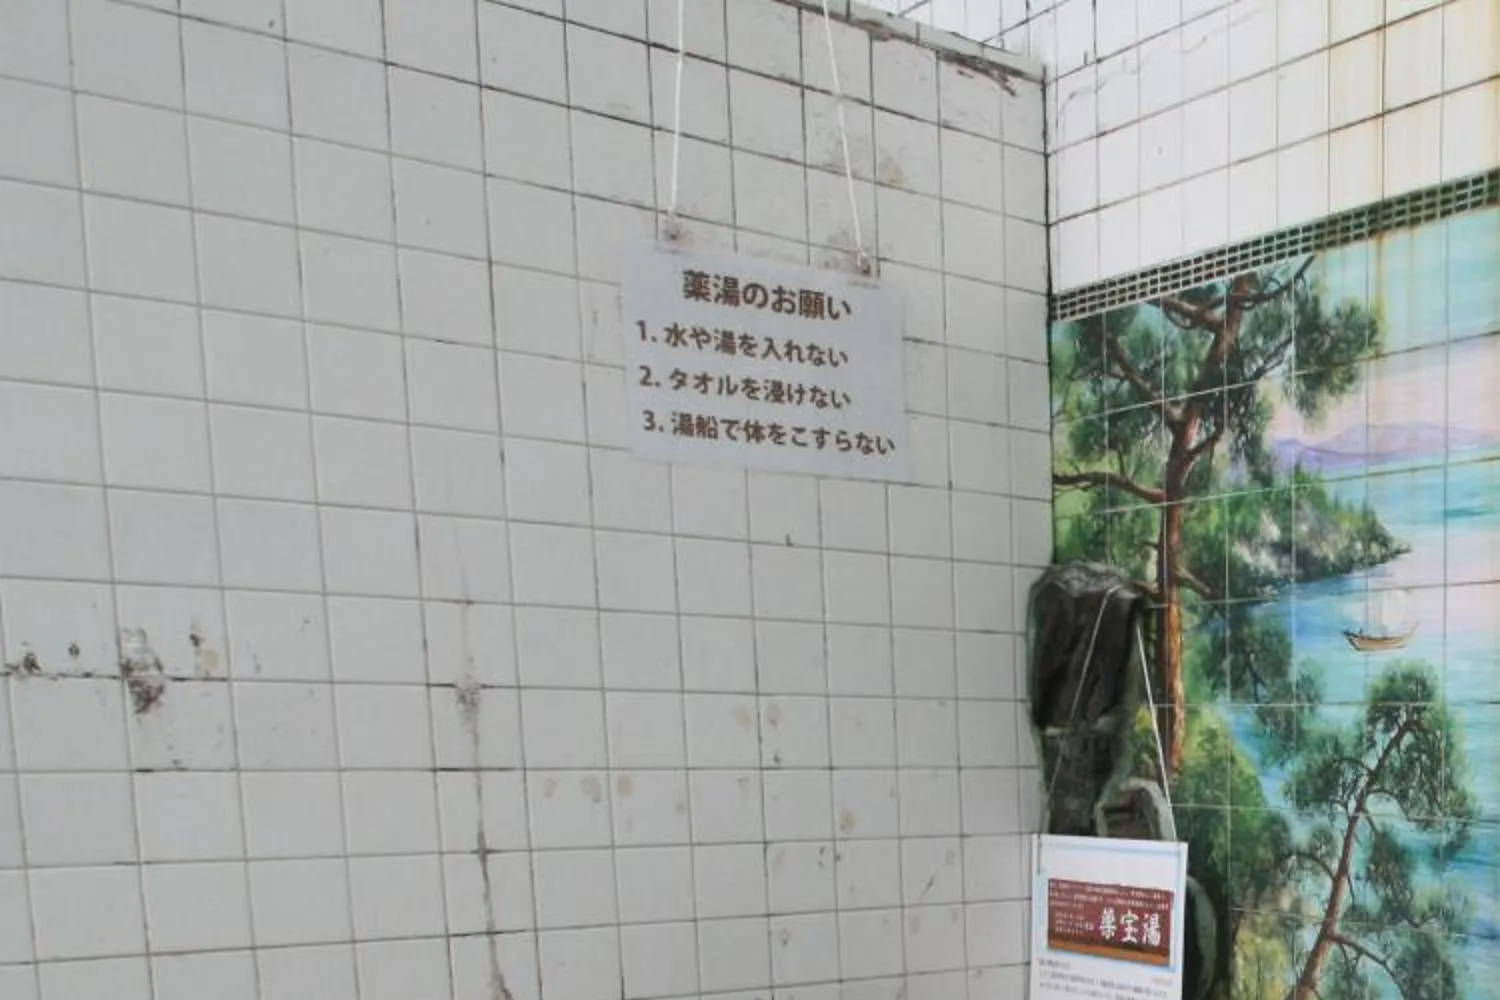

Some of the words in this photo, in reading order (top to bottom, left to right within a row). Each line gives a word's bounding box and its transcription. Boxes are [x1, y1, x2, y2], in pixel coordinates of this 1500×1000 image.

[683, 269, 851, 320] 薬湯のお願い
